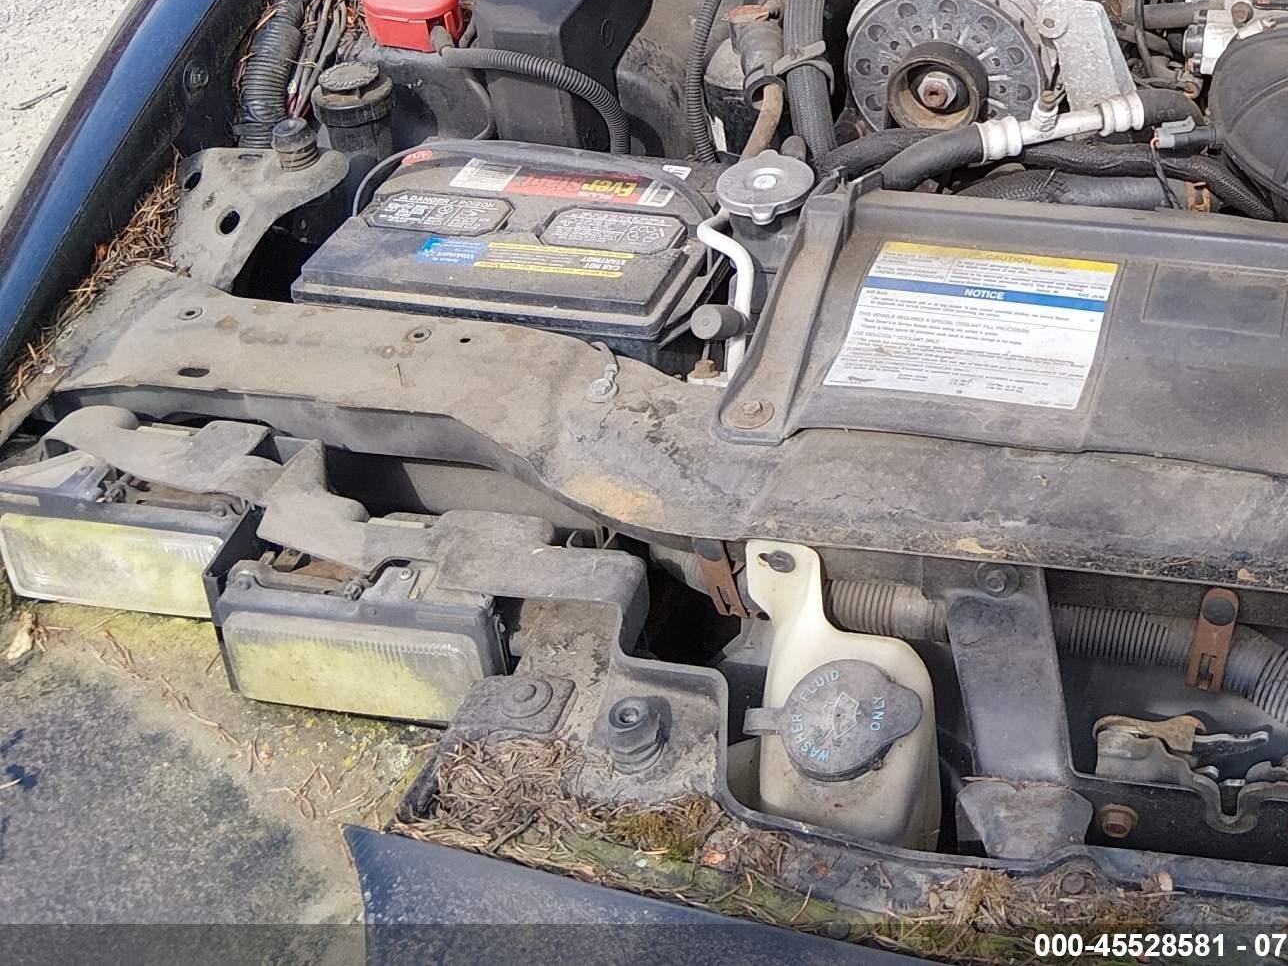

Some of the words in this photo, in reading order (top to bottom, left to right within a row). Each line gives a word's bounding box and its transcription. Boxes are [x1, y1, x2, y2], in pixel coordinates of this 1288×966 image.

[408, 194, 451, 206] DANGER
[457, 199, 496, 209] POISON
[986, 253, 1033, 265] CAUTION
[964, 287, 1006, 301] NOTICE
[801, 669, 841, 703] FLUID
[870, 695, 887, 732] ONLY
[792, 712, 832, 763] WASHER
